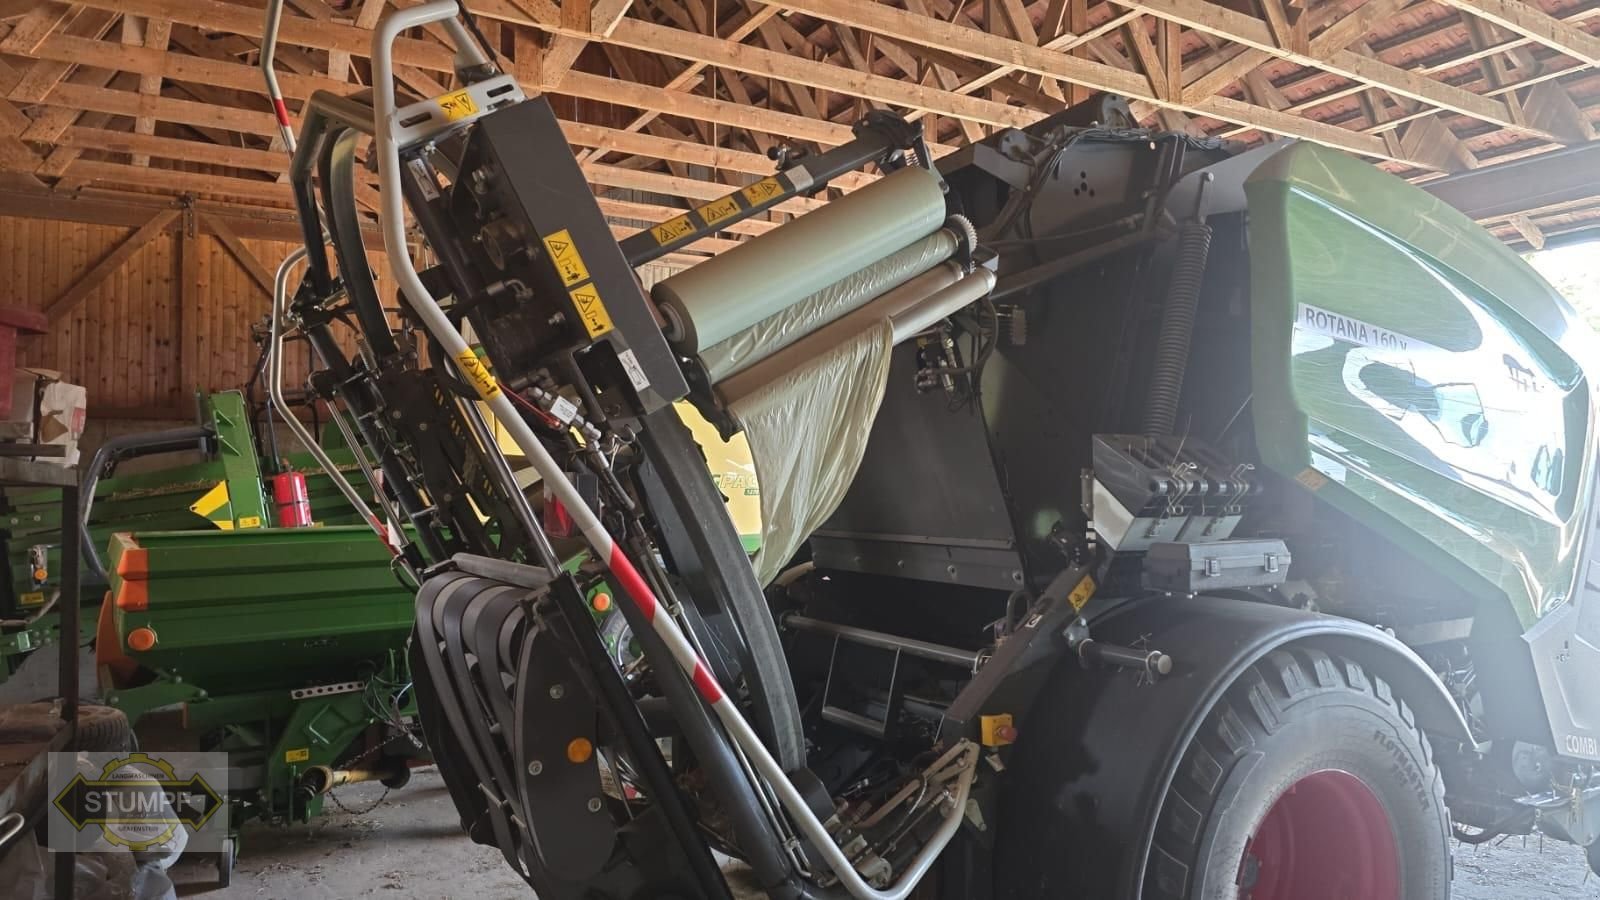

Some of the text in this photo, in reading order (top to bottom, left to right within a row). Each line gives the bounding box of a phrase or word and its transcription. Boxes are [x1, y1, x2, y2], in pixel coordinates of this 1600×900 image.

[1305, 307, 1368, 343] ROTANA
[1372, 328, 1397, 350] 160
[1566, 734, 1598, 756] COMBI
